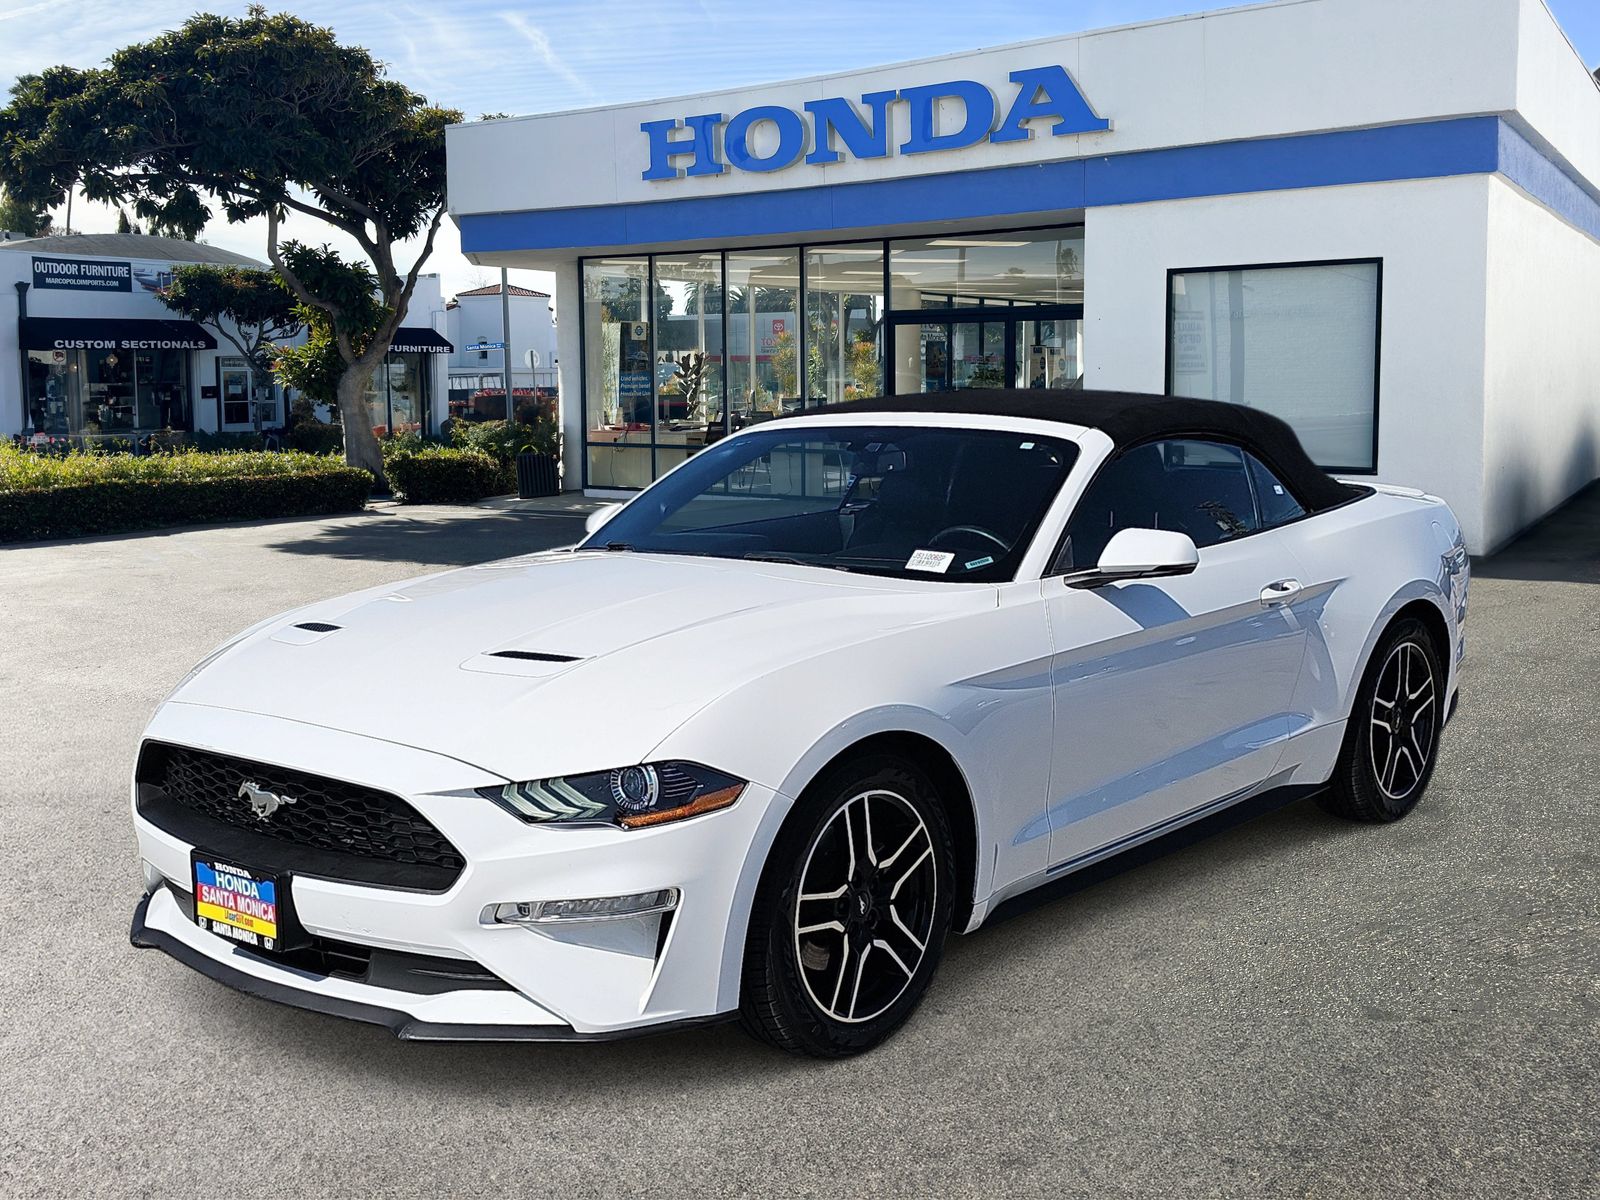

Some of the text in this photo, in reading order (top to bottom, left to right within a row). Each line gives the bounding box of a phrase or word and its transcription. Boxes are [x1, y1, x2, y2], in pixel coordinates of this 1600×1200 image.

[640, 64, 1112, 181] HONDA
[34, 261, 130, 278] OUTDOOR FURNITURE
[45, 277, 119, 287] MARCOPOLOIMPORTS.COM
[54, 339, 206, 349] CUSTOM SECTIONALS
[388, 345, 450, 353] FURNITURE
[214, 862, 252, 878] HONDA
[215, 871, 260, 899] HONDA
[202, 886, 275, 922] SANTA MONICA
[212, 920, 258, 945] SANTA MONICA
